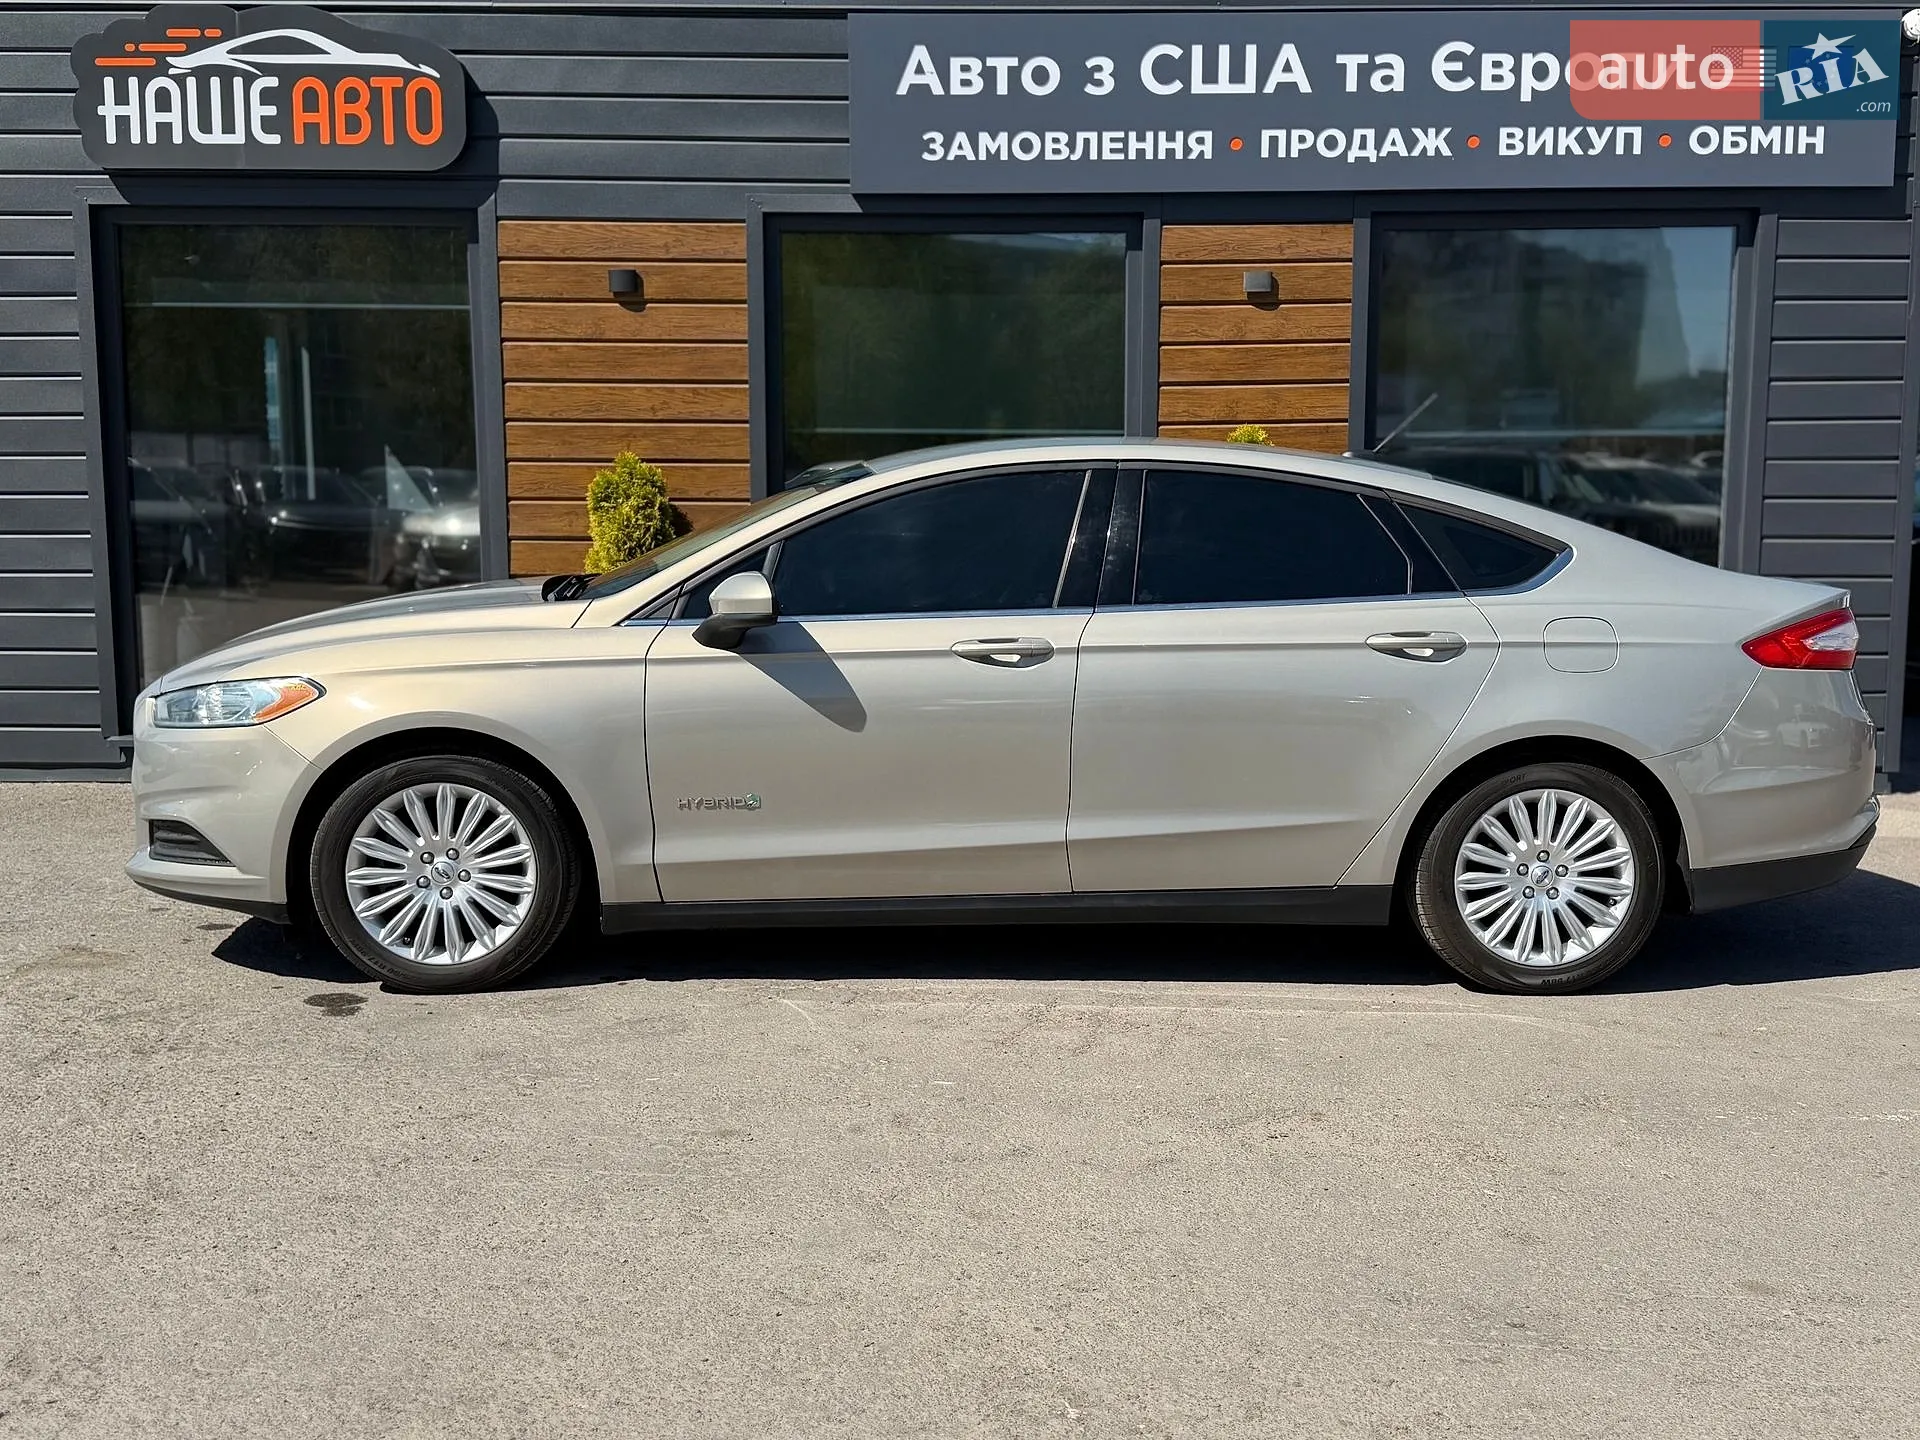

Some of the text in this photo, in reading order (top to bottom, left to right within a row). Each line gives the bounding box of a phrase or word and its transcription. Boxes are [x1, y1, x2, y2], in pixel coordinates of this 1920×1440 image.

[896, 44, 1061, 96] Авто
[1084, 56, 1115, 96] з
[1140, 43, 1313, 96] США
[1335, 54, 1405, 93] та
[98, 76, 443, 146] НАШЕ АВТО
[921, 125, 1825, 163] ЗАМОВЛЕННЯ ПРОДАЖ ВИКУП ОБМІН
[677, 796, 746, 810] HYBRID
